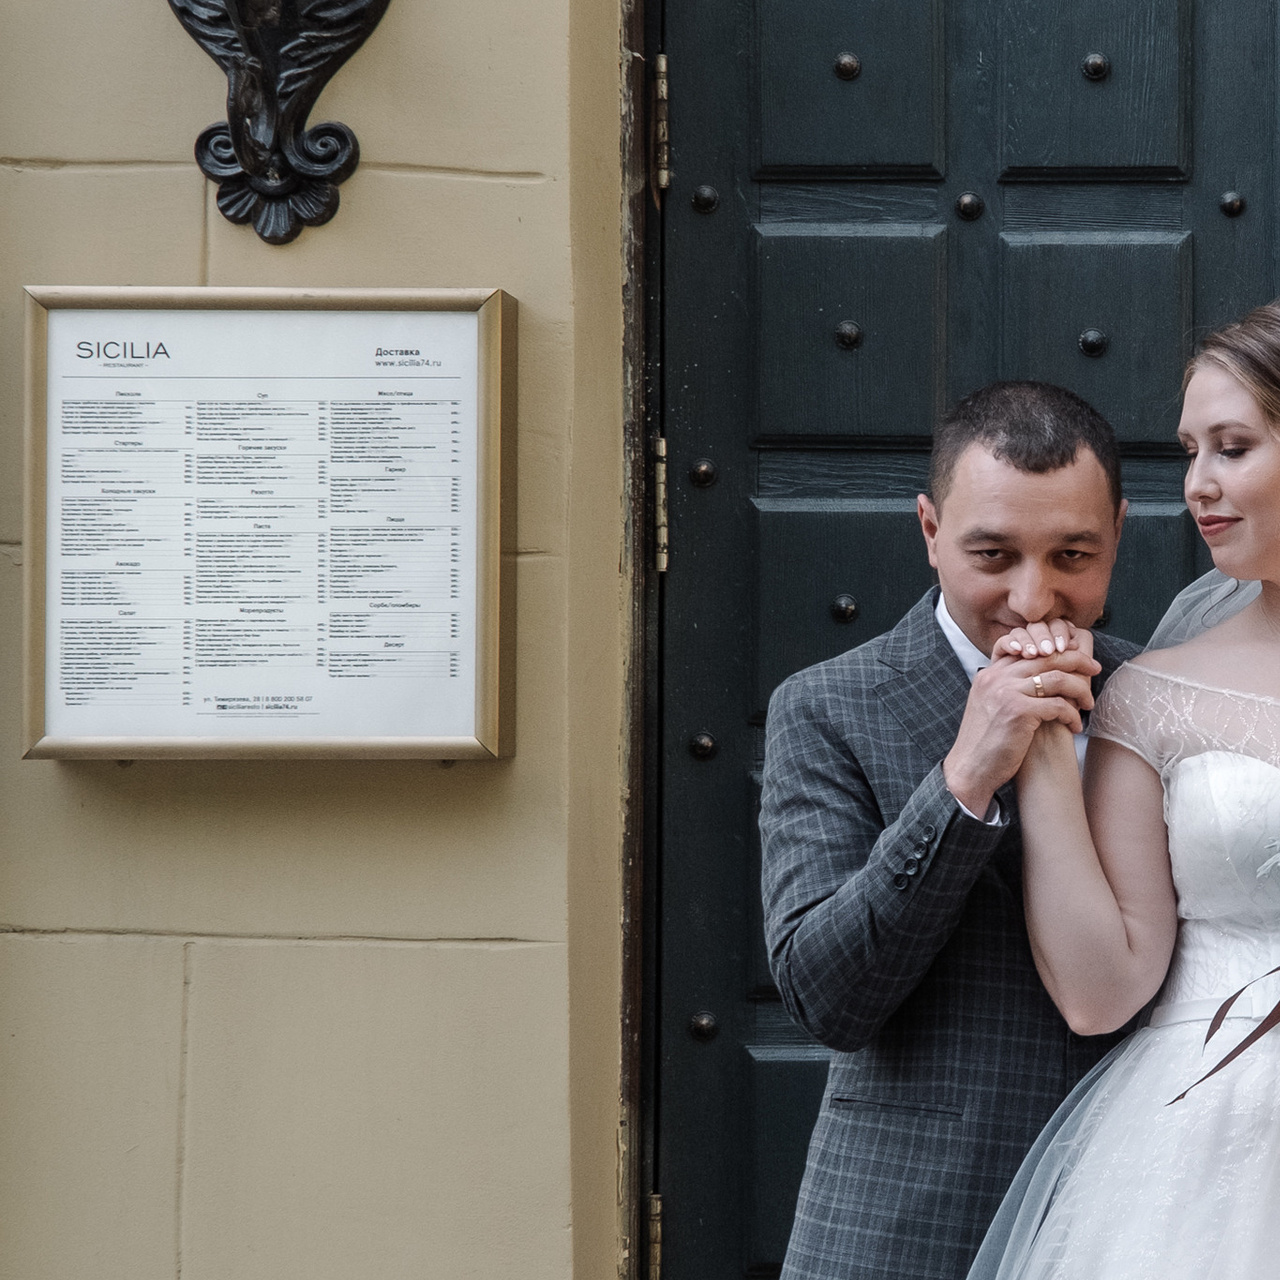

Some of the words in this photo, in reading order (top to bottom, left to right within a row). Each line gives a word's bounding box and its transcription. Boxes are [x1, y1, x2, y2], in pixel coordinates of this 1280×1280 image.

[76, 341, 171, 359] SICILIA
[375, 347, 421, 357] Доставка
[375, 358, 442, 367] www.sicilia74.ru
